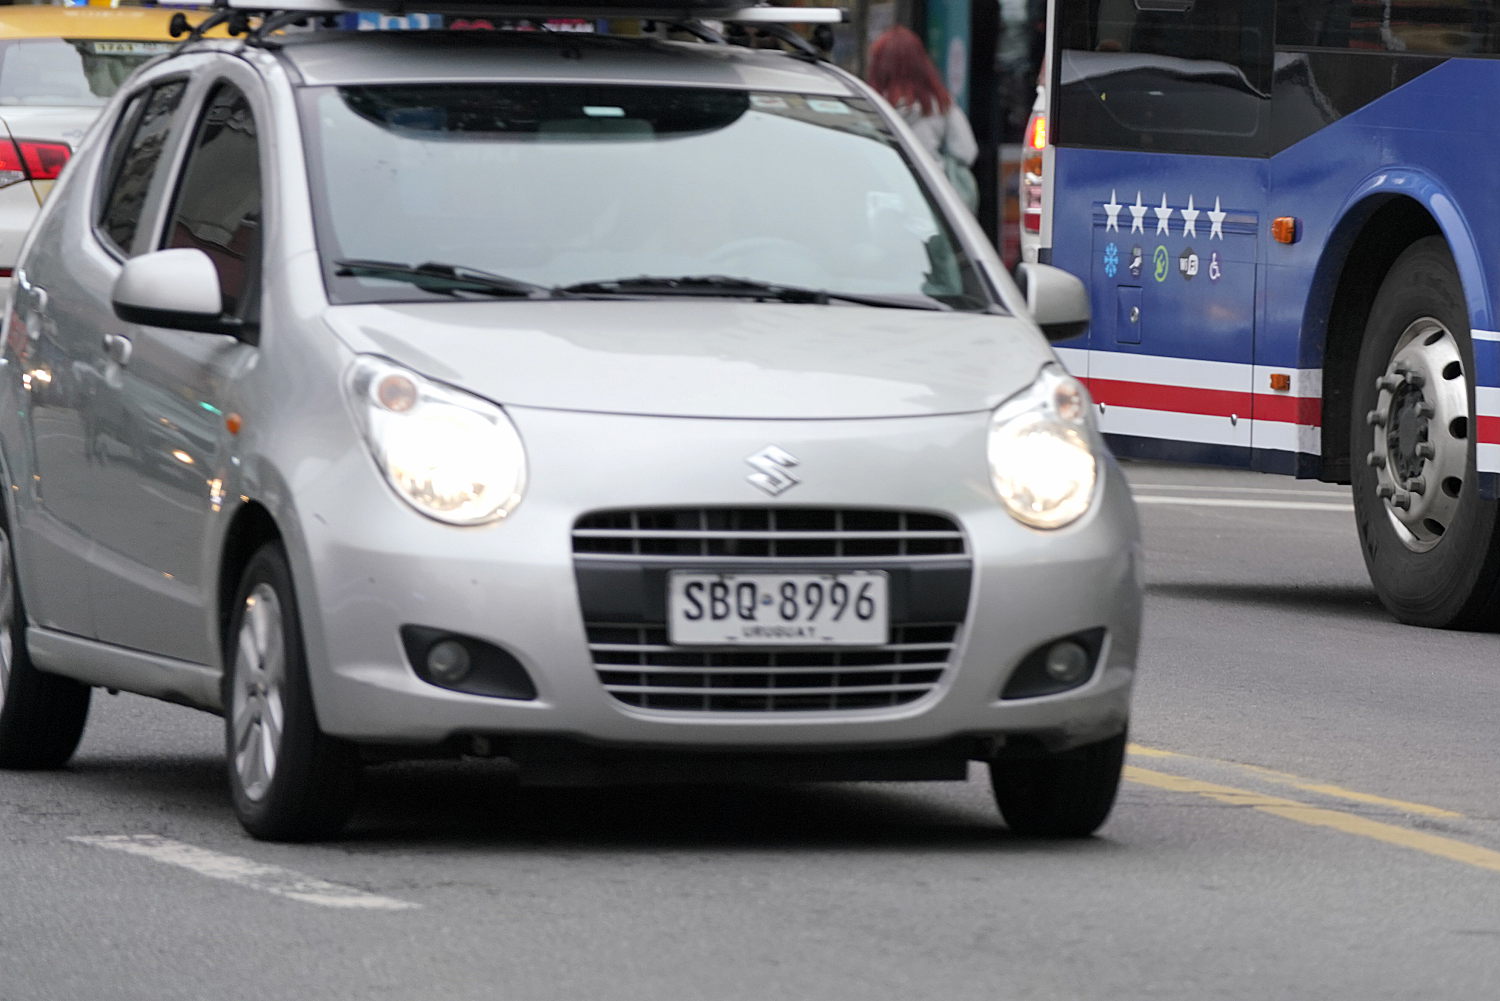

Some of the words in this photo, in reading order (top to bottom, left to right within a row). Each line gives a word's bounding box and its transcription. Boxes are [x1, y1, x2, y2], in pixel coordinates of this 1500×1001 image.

[684, 581, 757, 621] SBQ
[780, 581, 875, 621] 8996
[742, 625, 816, 638] URUGUAY
